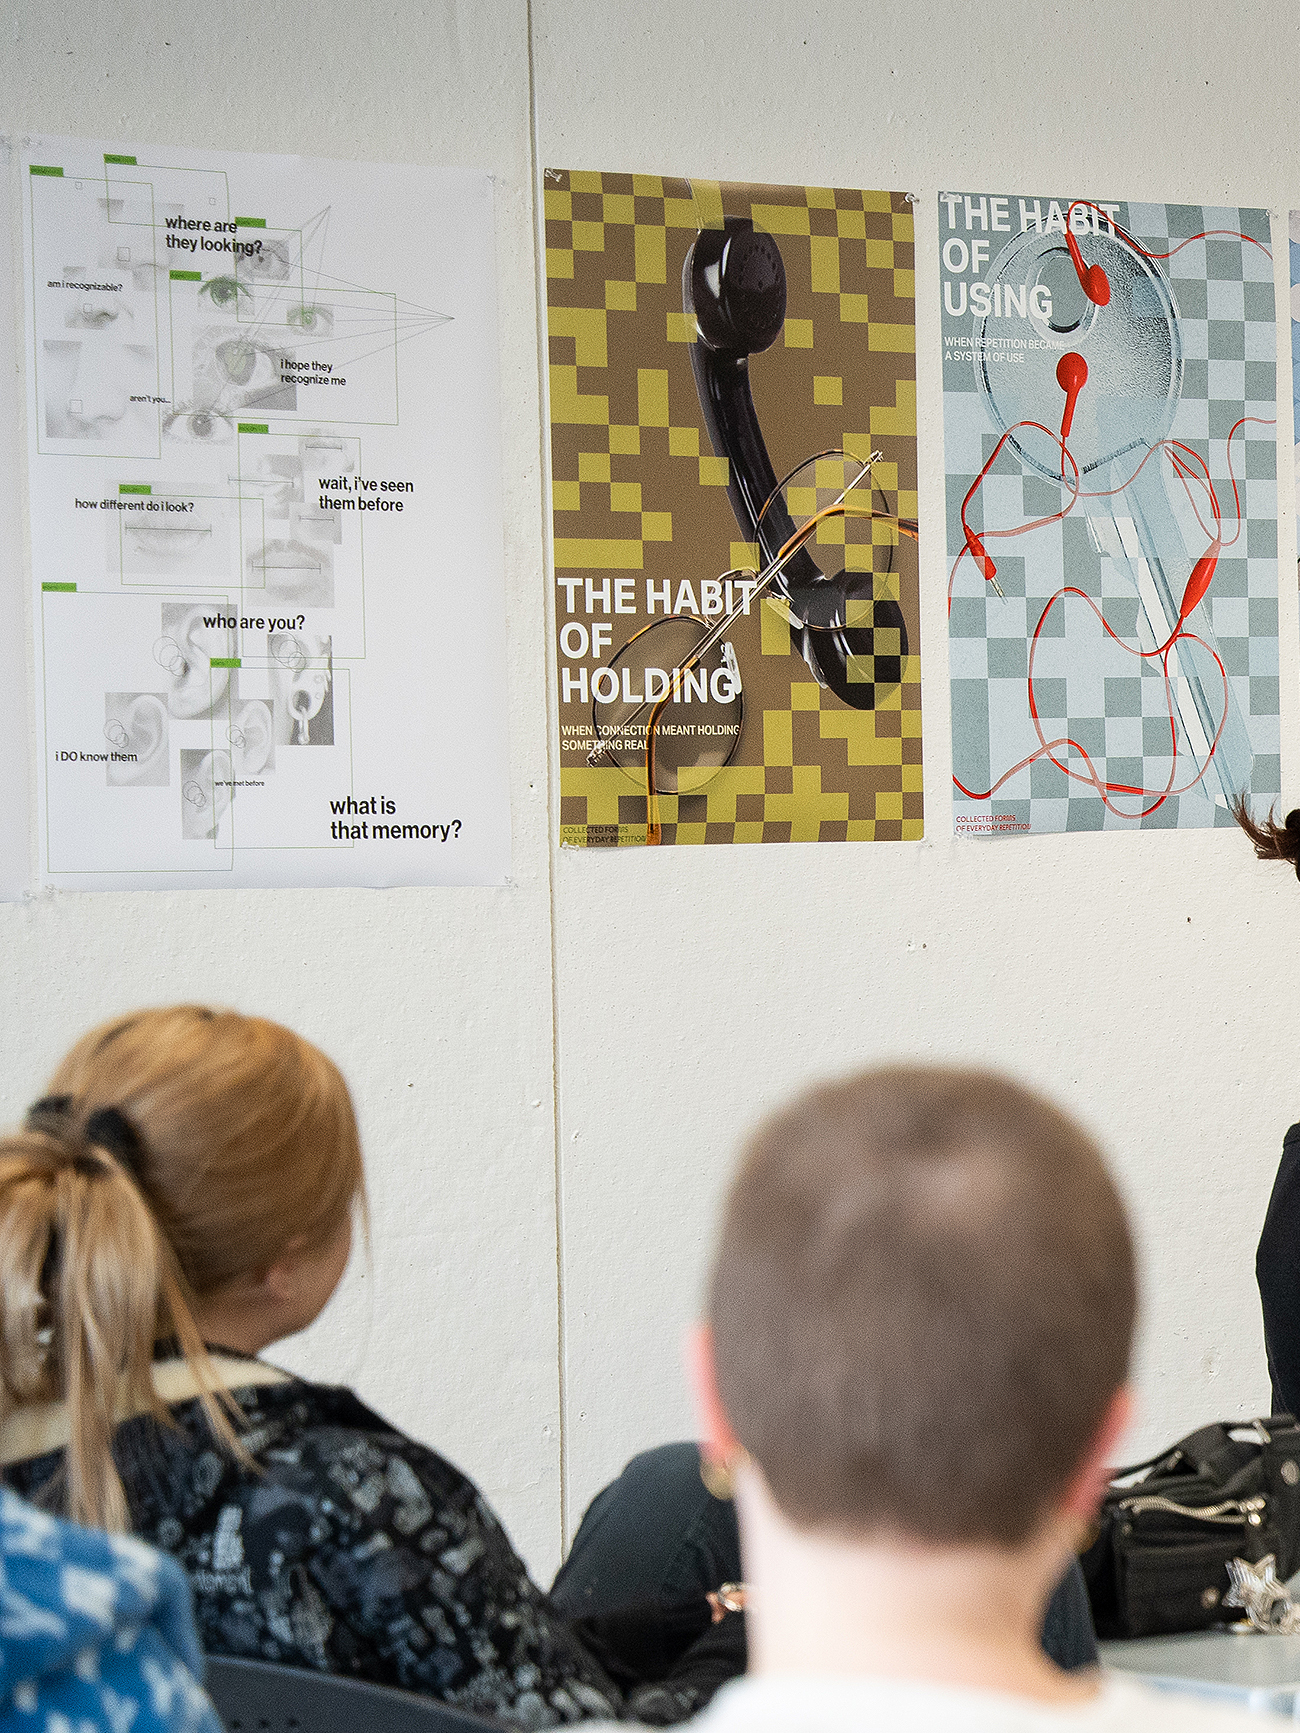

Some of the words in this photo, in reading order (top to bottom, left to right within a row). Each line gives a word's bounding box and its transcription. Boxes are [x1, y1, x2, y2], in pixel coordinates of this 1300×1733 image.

[165, 215, 211, 231] where
[214, 221, 238, 233] are
[942, 194, 1011, 233] THE
[1018, 198, 1120, 238] HABIT
[165, 234, 198, 252] they
[200, 236, 263, 257] looking?
[942, 237, 990, 274] OF
[47, 280, 60, 288] am
[66, 281, 123, 292] recognizable?
[943, 281, 1053, 320] USING
[944, 336, 973, 347] WHEN
[975, 337, 1028, 349] REPETITION
[944, 350, 953, 361] A
[953, 350, 991, 362] SYSTEM
[992, 352, 1006, 362] OF
[1008, 353, 1025, 363] USE
[285, 359, 310, 372] hope
[311, 360, 333, 374] they
[280, 374, 329, 386] recognize
[331, 376, 346, 386] me
[319, 475, 352, 493] wait,
[354, 476, 378, 491] i've
[380, 480, 414, 492] seen
[75, 498, 98, 509] how
[100, 499, 145, 511] different
[146, 501, 159, 512] do
[165, 502, 194, 512] look?
[319, 495, 355, 510] them
[358, 496, 404, 512] before
[558, 577, 637, 614] THE
[646, 578, 758, 616] HABIT
[203, 613, 237, 629] who
[239, 618, 265, 629] are
[268, 614, 306, 633] you?
[559, 622, 613, 660] OF
[561, 667, 738, 704] HOLDING
[561, 725, 593, 736] WHEN
[662, 725, 697, 736] MEANT
[698, 725, 741, 736] HOLDING
[624, 740, 650, 750] REAL
[60, 751, 78, 761] DO
[80, 751, 109, 762] know
[110, 751, 138, 762] them
[329, 795, 377, 815] what
[380, 795, 397, 815] is
[956, 815, 994, 823] COLLECTED
[330, 820, 369, 839] that
[372, 819, 463, 843] memory?
[966, 824, 999, 832] EVERYDAY
